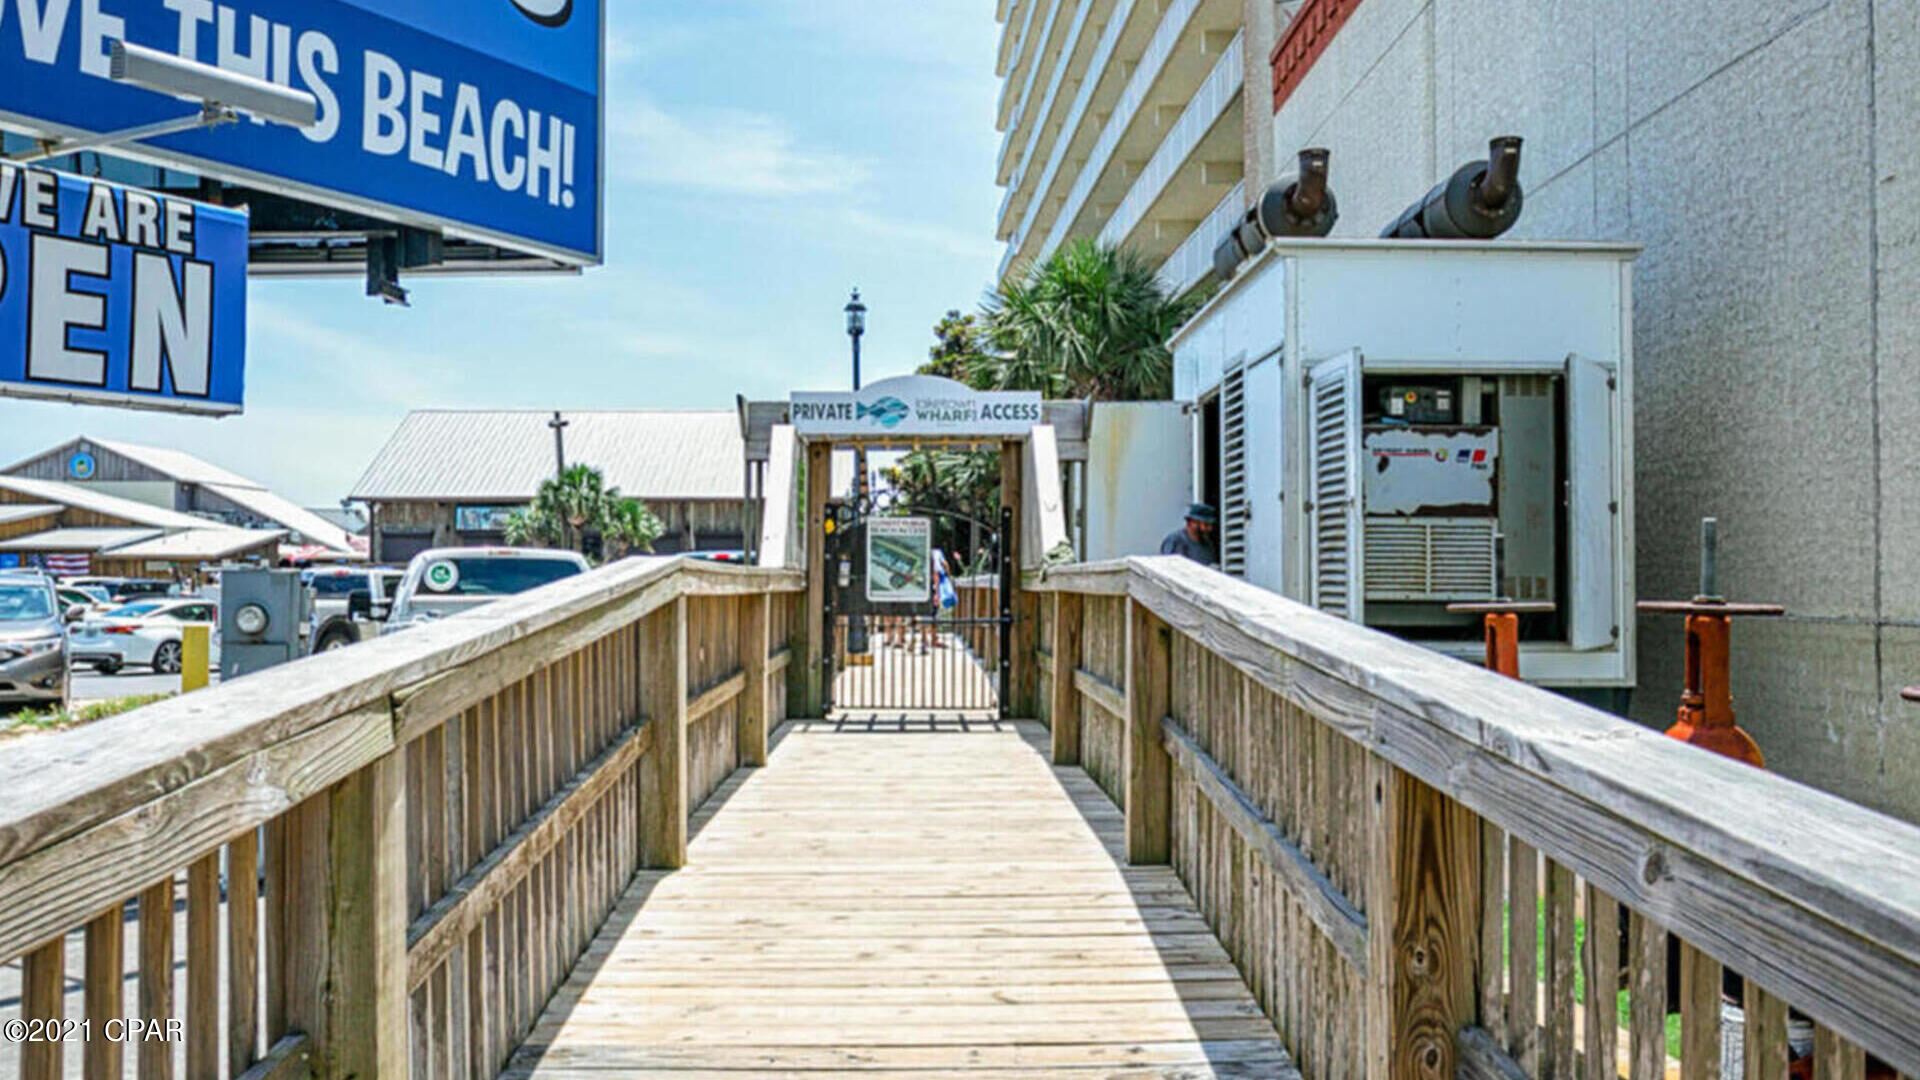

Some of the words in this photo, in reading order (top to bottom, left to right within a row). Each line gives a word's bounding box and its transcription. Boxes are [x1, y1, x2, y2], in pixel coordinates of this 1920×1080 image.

[0, 0, 125, 80] VE
[163, 0, 340, 142] THIS
[362, 49, 576, 208] BEACH!
[82, 181, 195, 257] ARE
[0, 231, 214, 398] EN
[792, 402, 853, 421] PRIVATE
[980, 402, 1039, 421] ACCESS
